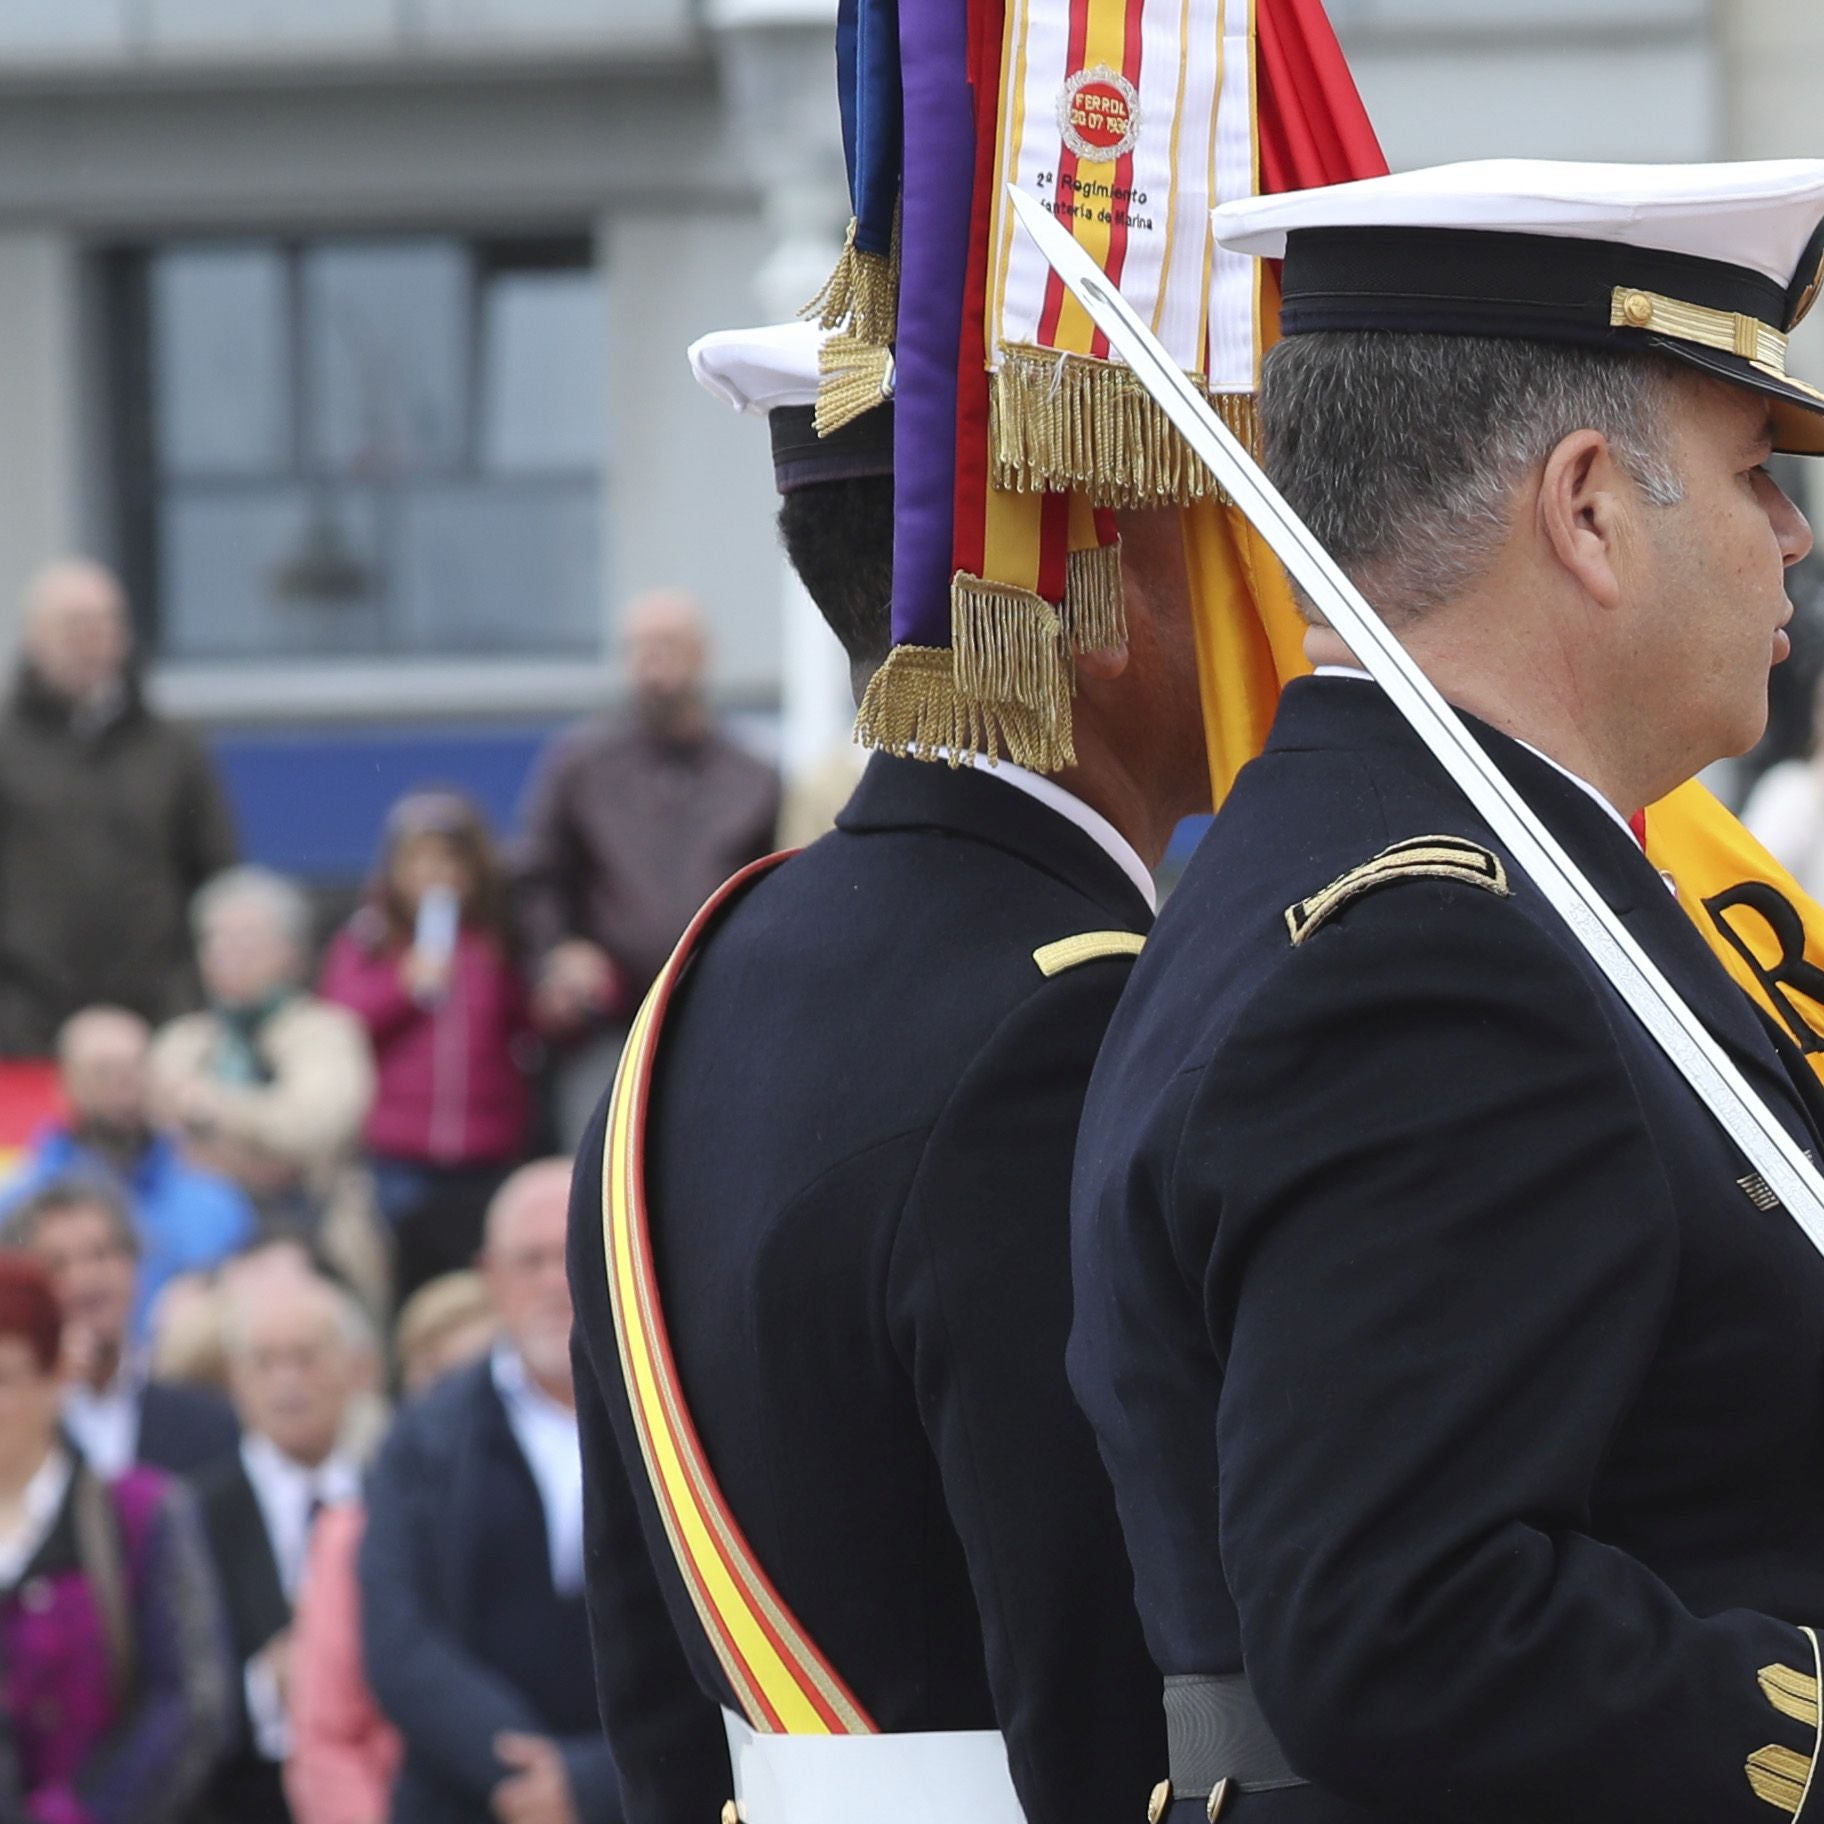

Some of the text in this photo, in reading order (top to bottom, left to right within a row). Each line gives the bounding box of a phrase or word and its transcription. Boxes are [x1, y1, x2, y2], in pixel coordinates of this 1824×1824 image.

[1075, 92, 1127, 117] FERROL
[1088, 112, 1104, 131] 07
[1061, 173, 1148, 205] Regimiento
[1097, 208, 1112, 223] de
[1114, 209, 1153, 231] Marina
